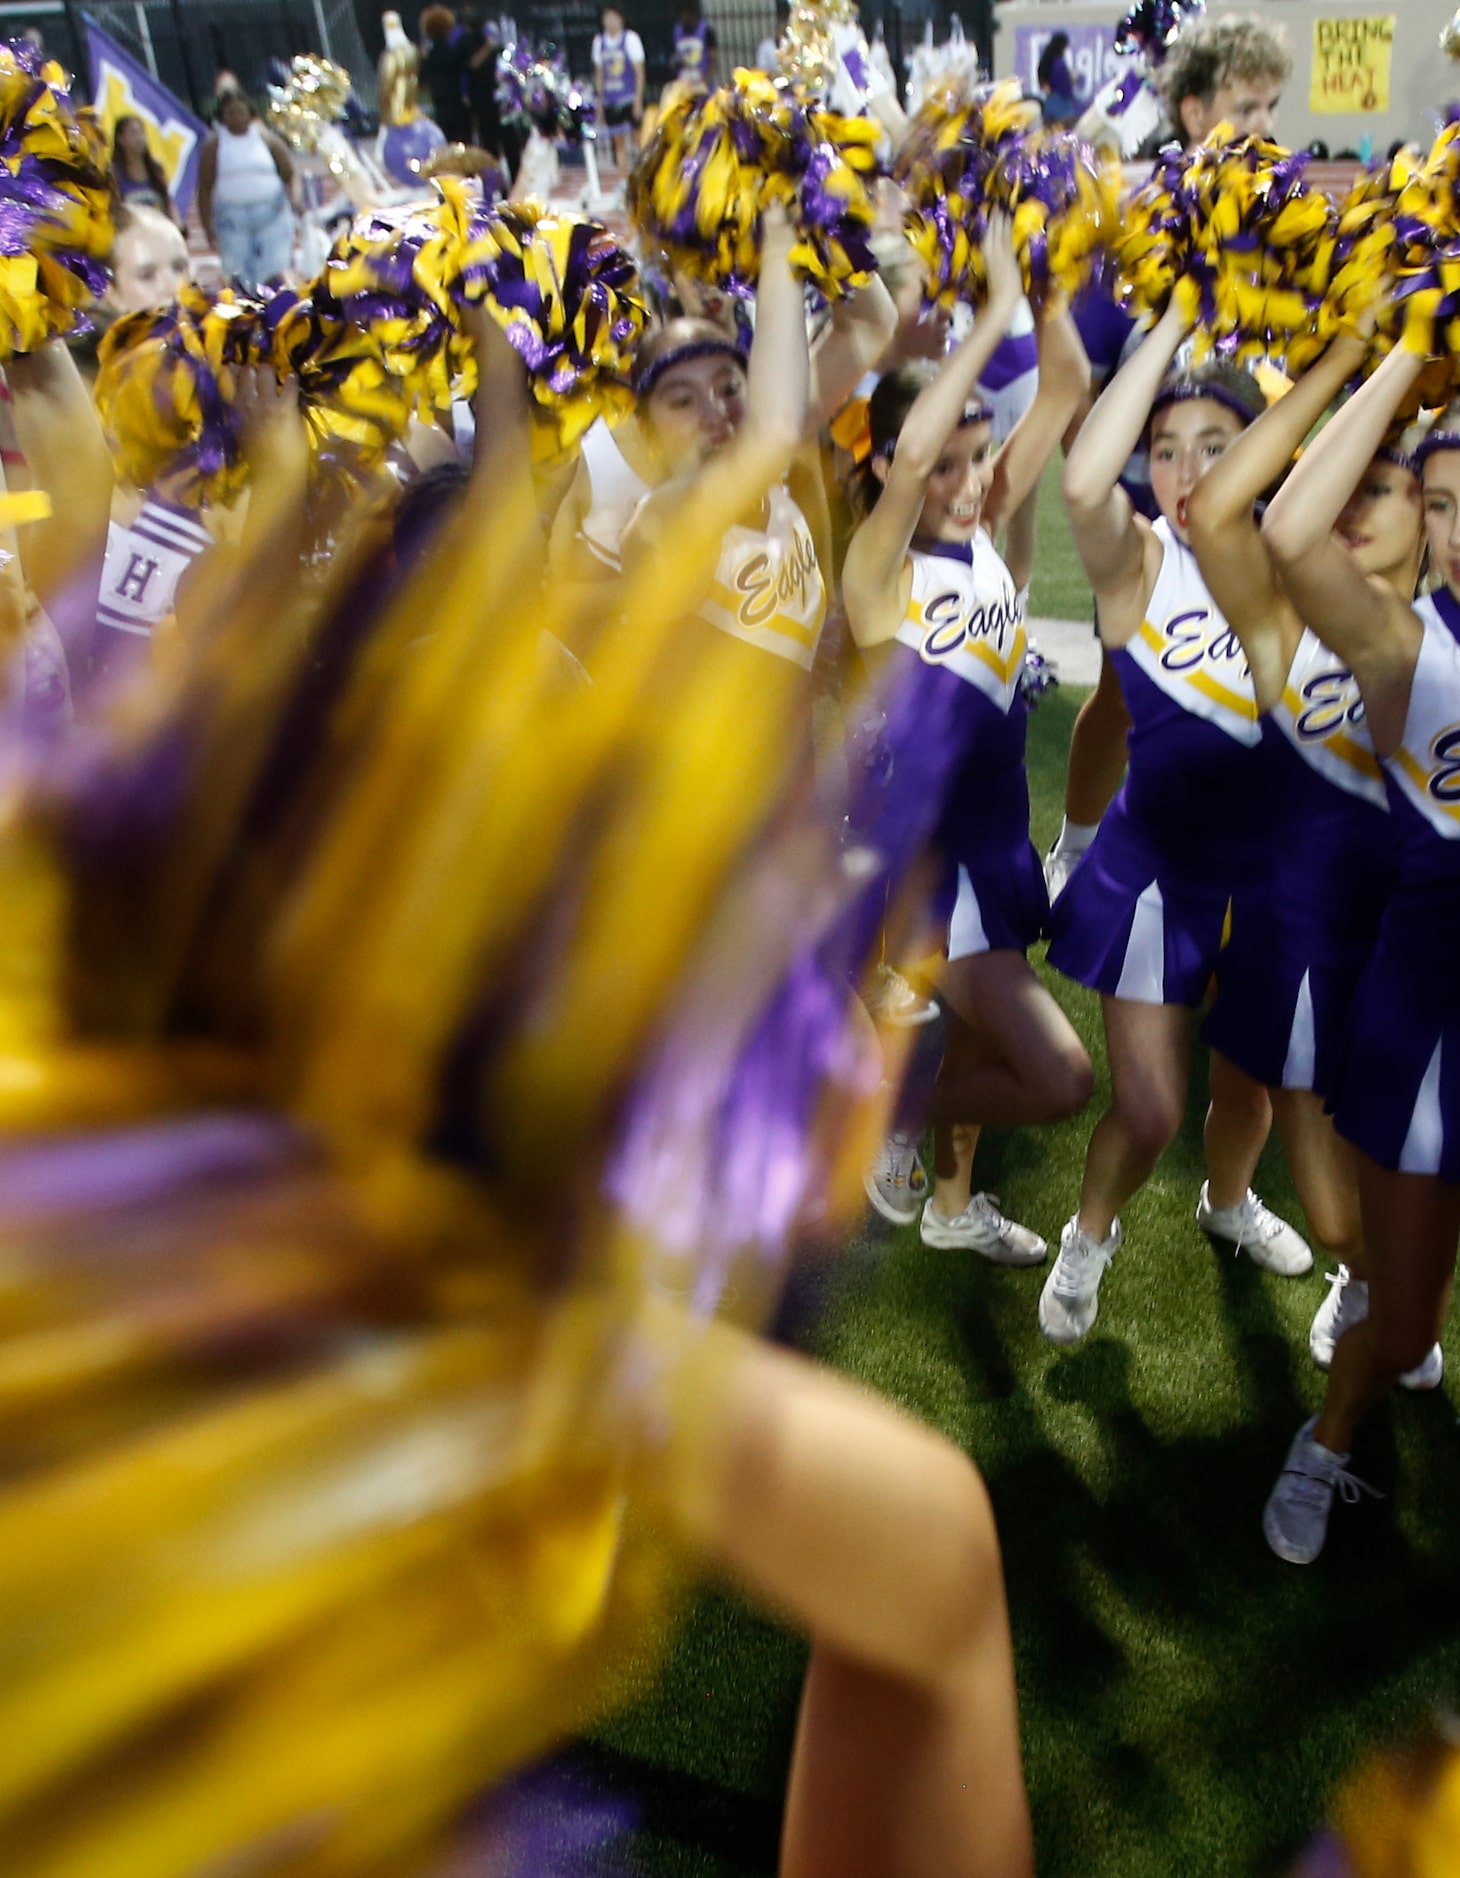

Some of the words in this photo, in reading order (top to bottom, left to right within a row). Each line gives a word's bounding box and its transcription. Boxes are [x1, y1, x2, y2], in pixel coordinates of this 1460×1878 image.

[1321, 46, 1366, 72] THE
[1321, 65, 1376, 97] HEAT
[115, 552, 158, 604] H
[1158, 606, 1251, 685] Ea
